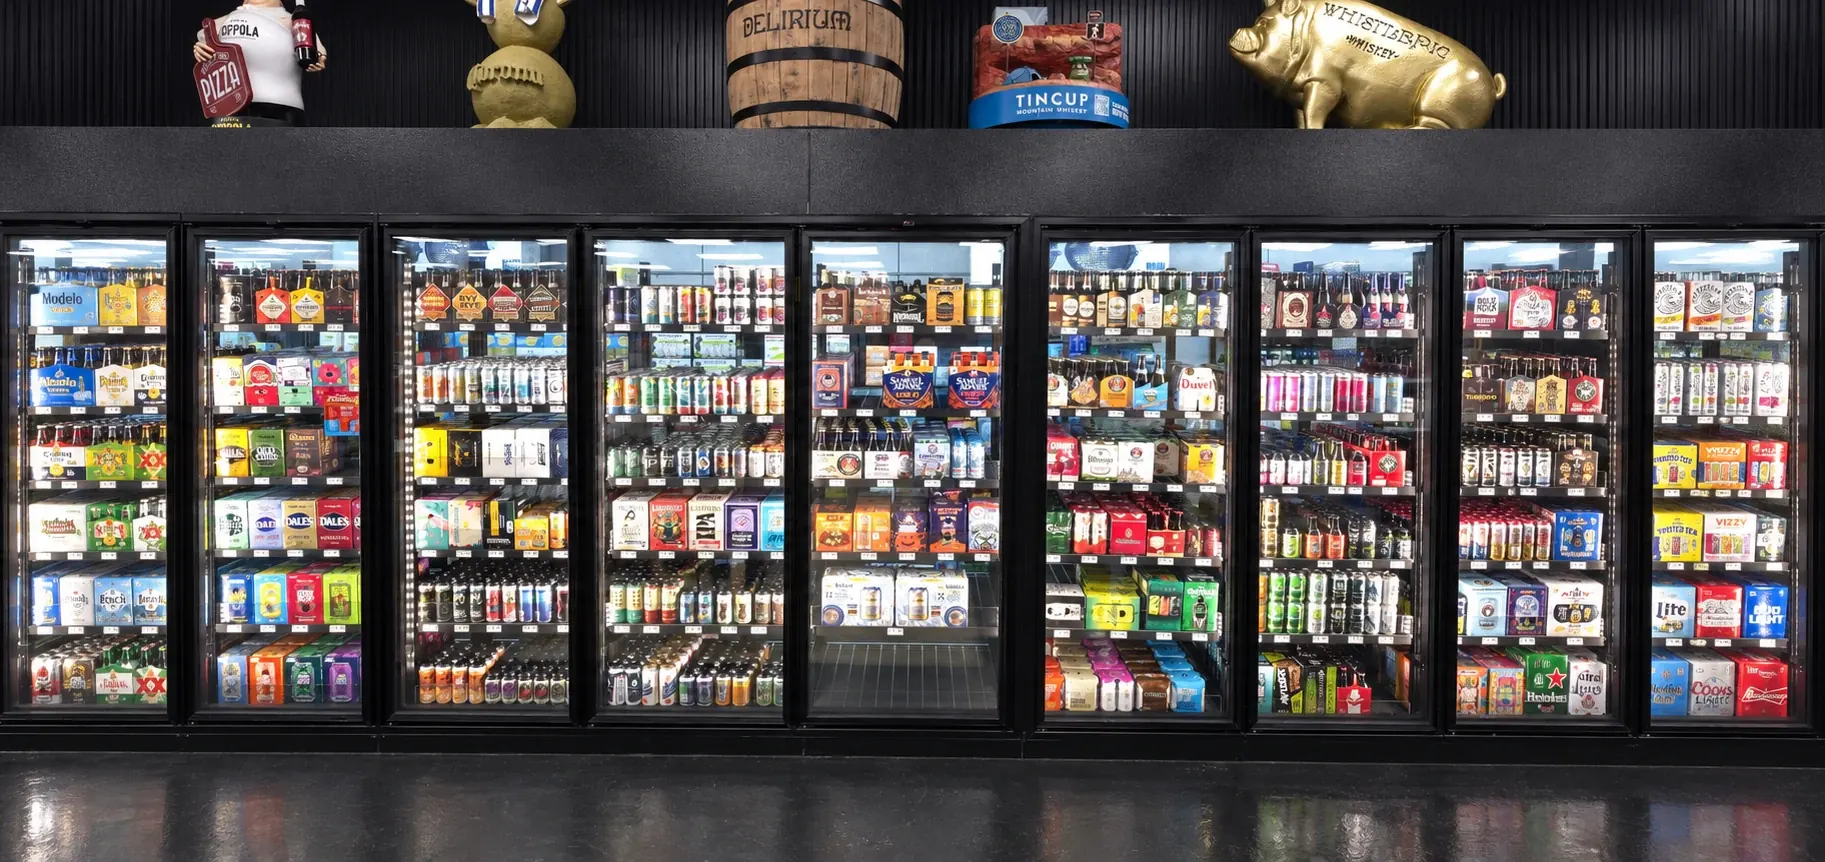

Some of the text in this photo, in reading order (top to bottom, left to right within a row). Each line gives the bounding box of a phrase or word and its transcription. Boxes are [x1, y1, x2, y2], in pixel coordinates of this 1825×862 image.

[221, 24, 260, 38] OPPOLA
[742, 9, 852, 38] DELIRIUM
[200, 61, 241, 105] PIZZA
[1015, 92, 1089, 108] TINCUP
[42, 292, 83, 305] Modelo
[1181, 378, 1213, 391] Duvel
[1715, 518, 1748, 527] VIZZY
[1655, 601, 1687, 620] Lite
